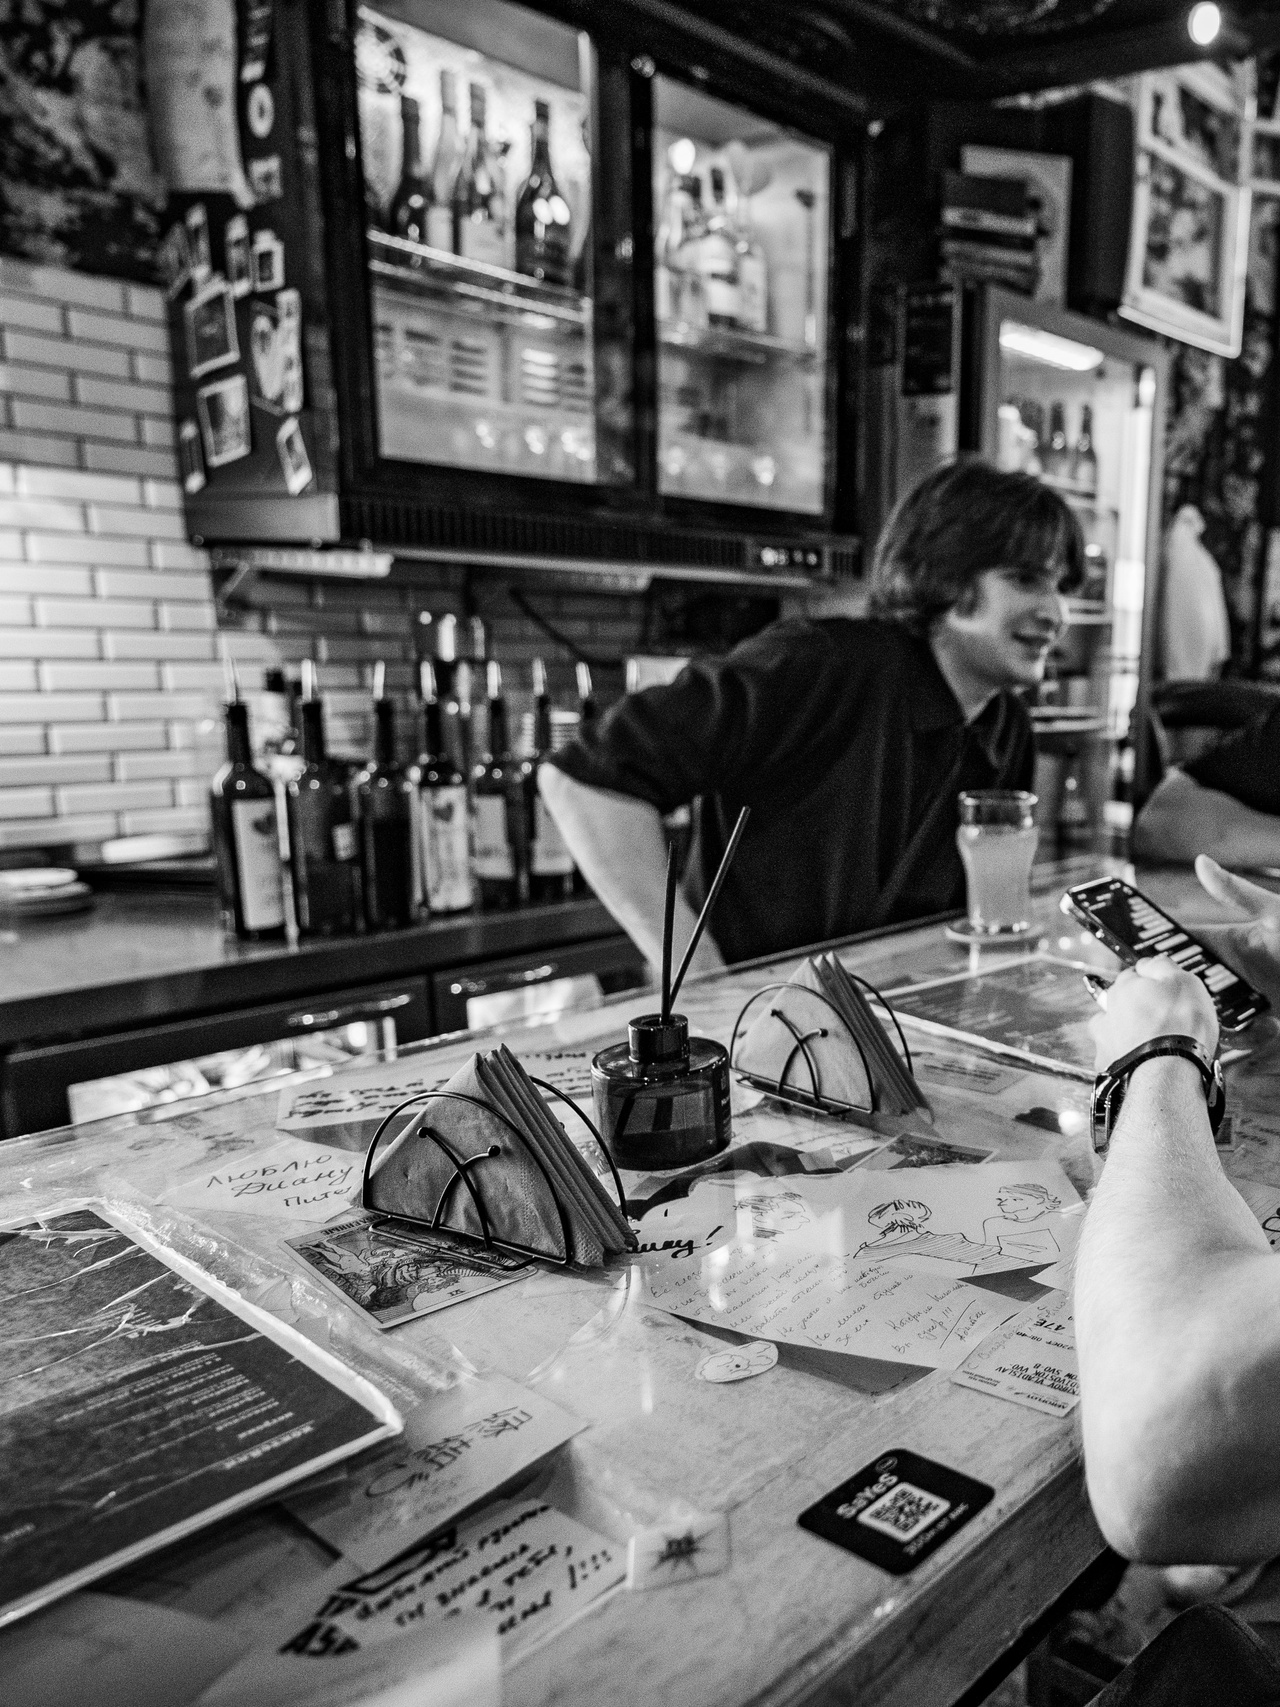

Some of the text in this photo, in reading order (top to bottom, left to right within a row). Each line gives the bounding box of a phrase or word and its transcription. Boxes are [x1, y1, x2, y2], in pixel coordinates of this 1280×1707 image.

[206, 1154, 332, 1188] ЛЮБЛЮ
[1033, 1319, 1066, 1332] 47E
[995, 1366, 1044, 1386] VLADISLAV
